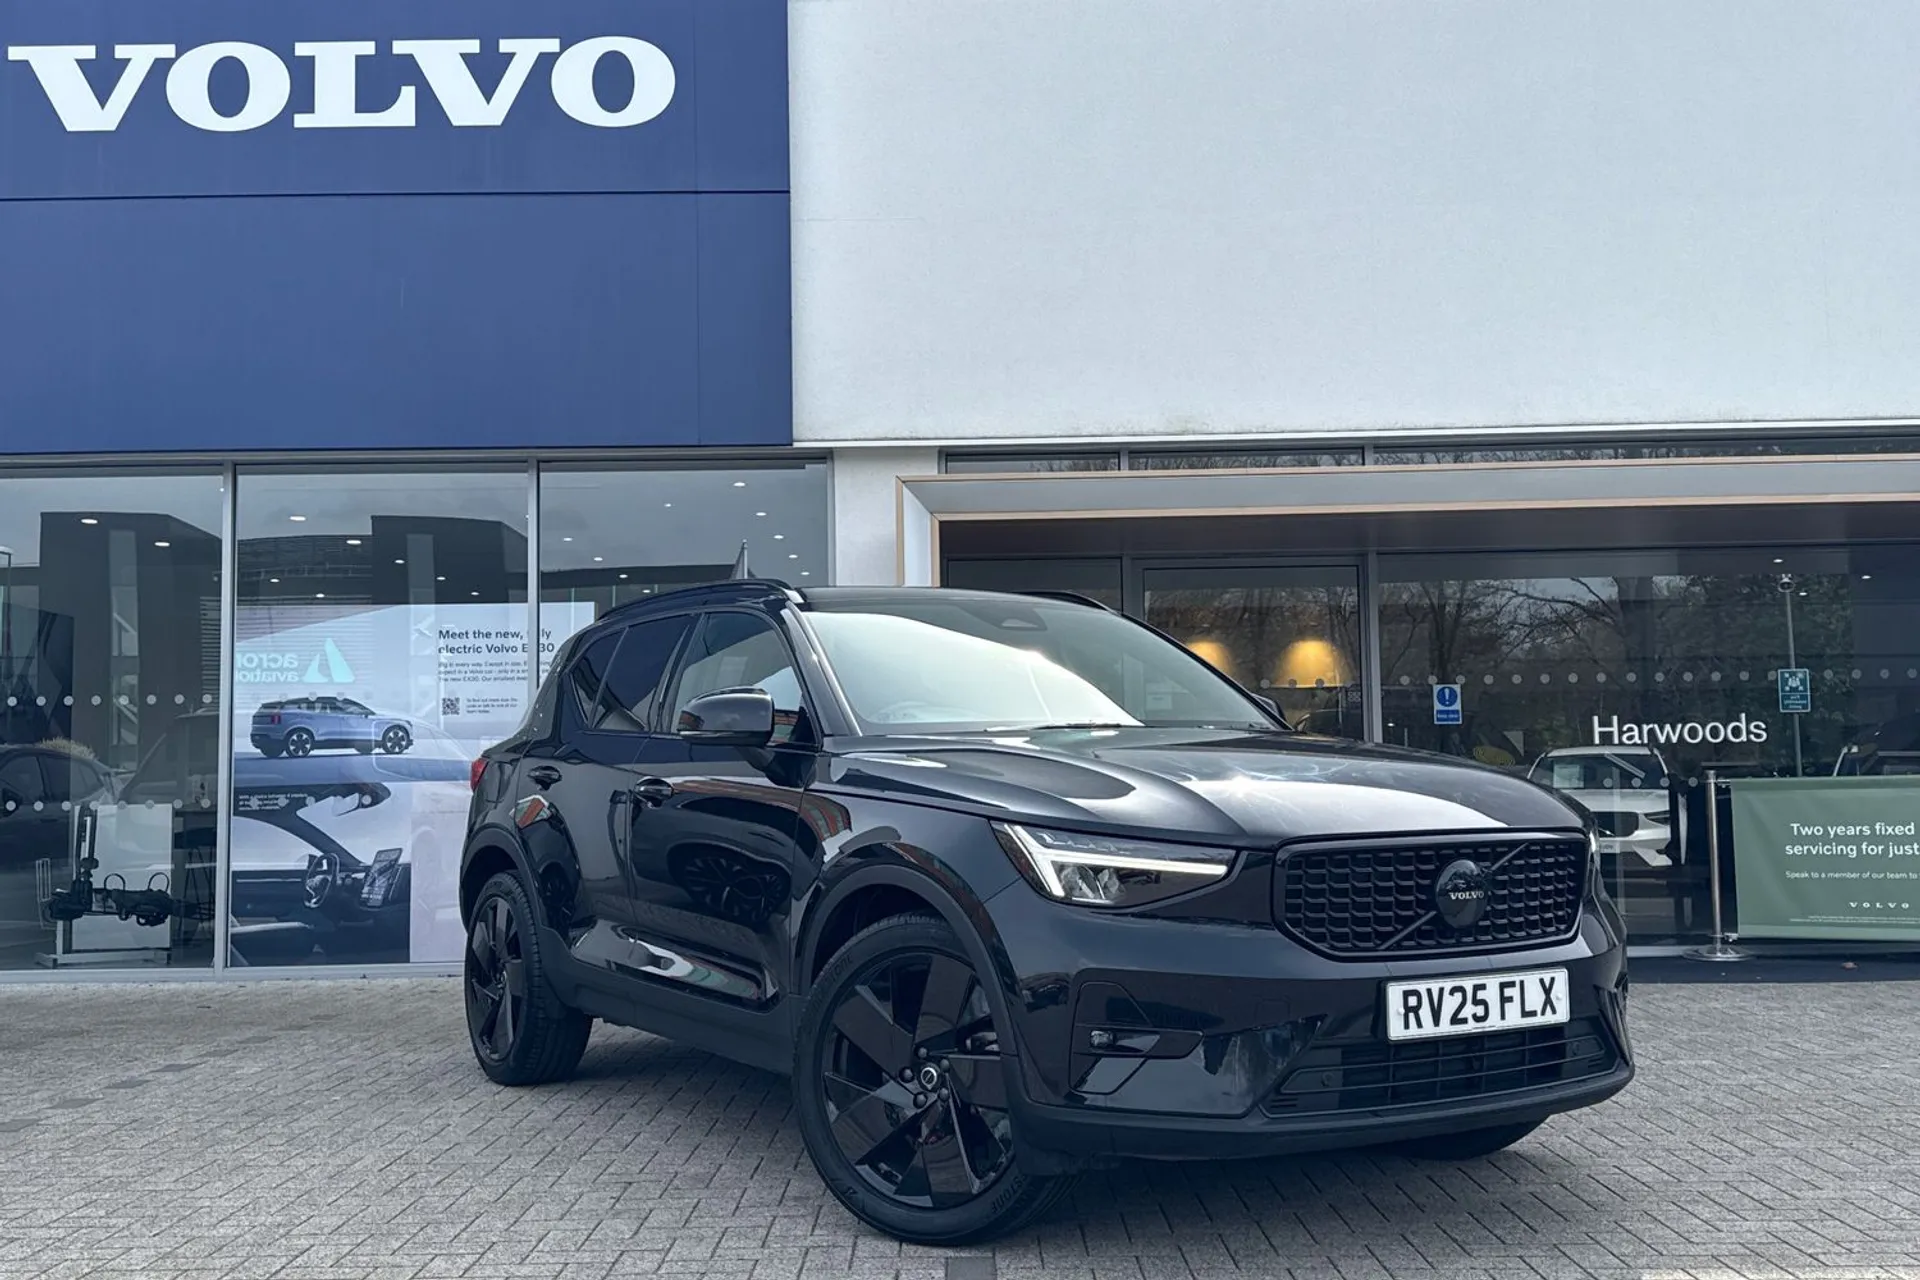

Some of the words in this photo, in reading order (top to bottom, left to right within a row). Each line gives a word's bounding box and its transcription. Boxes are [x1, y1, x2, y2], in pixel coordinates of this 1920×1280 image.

[8, 36, 675, 131] VOLVO
[438, 630, 469, 640] Meet
[472, 630, 492, 639] the
[495, 631, 524, 640] new,
[438, 643, 482, 654] electric
[486, 643, 518, 654] Volvo
[522, 642, 555, 653] E30
[1592, 713, 1768, 745] Harwoods
[1790, 823, 1823, 836] Two
[1828, 824, 1871, 838] years
[1875, 822, 1915, 836] fixed
[1785, 842, 1857, 858] servicing
[1861, 842, 1884, 855] for
[1888, 842, 1920, 858] just
[1785, 870, 1809, 879] Speak
[1828, 871, 1860, 879] member
[1887, 871, 1907, 879] team
[1909, 871, 1918, 879] to
[1448, 891, 1484, 900] VOLVO
[1402, 983, 1490, 1030] RV25
[1499, 976, 1557, 1021] FLX
